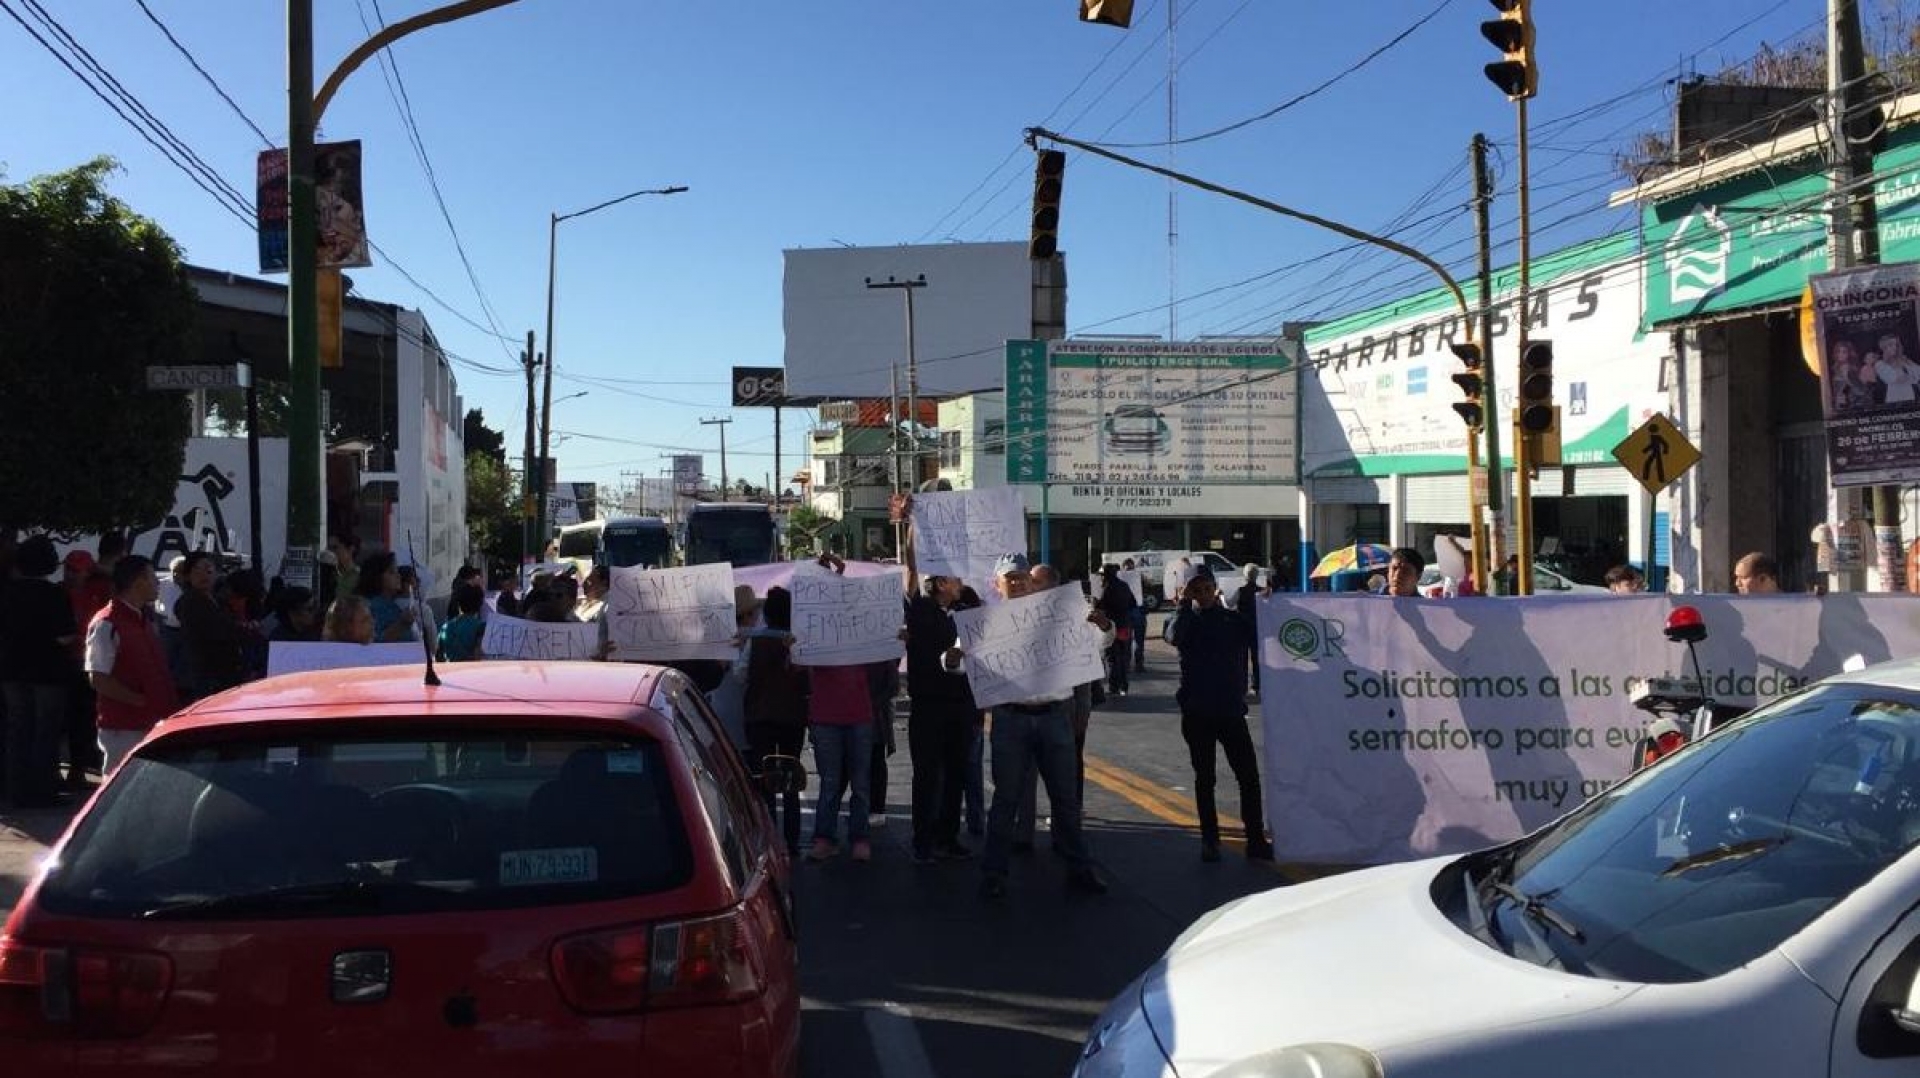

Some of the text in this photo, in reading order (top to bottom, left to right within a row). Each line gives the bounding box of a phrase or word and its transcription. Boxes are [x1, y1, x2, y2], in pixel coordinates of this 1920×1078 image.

[1343, 670, 1527, 698] Solicitamos
[1539, 675, 1560, 696] a
[1573, 669, 1611, 695] las
[1349, 720, 1502, 750] semaforo
[1515, 729, 1592, 755] para
[1495, 778, 1567, 806] muy
